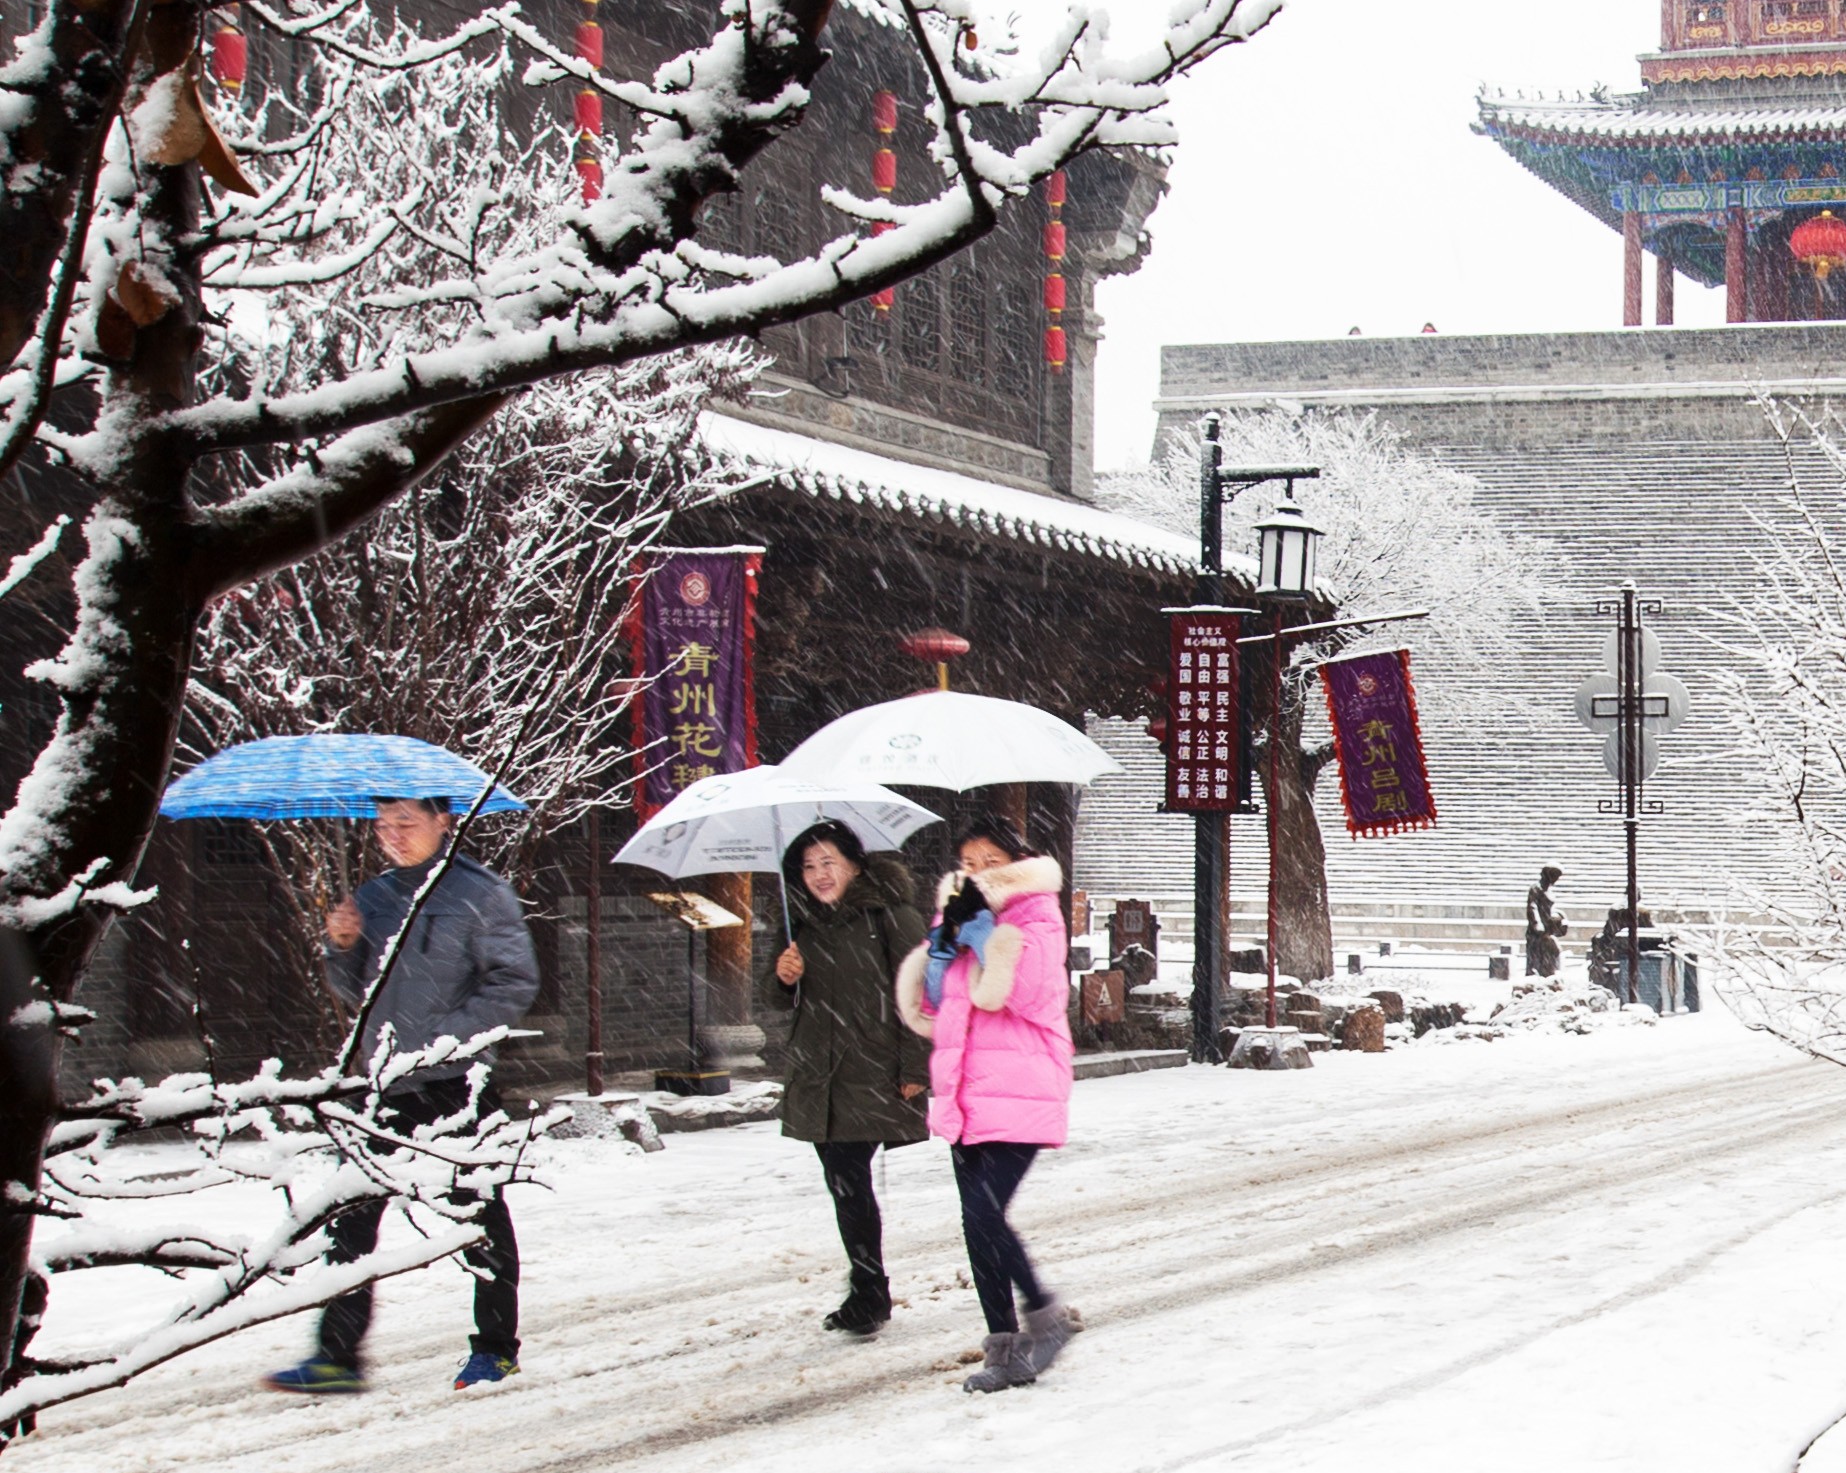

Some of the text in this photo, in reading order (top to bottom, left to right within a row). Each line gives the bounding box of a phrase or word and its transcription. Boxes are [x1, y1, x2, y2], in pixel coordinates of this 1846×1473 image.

[1183, 637, 1227, 647] 核心价值观
[1188, 626, 1222, 636] 社会主义
[1177, 653, 1192, 799] 爱国 敬业 诚信 友善
[1196, 653, 1211, 799] 自由 平等 公正 法治
[1214, 653, 1230, 799] 富强 民主 文明 和谐
